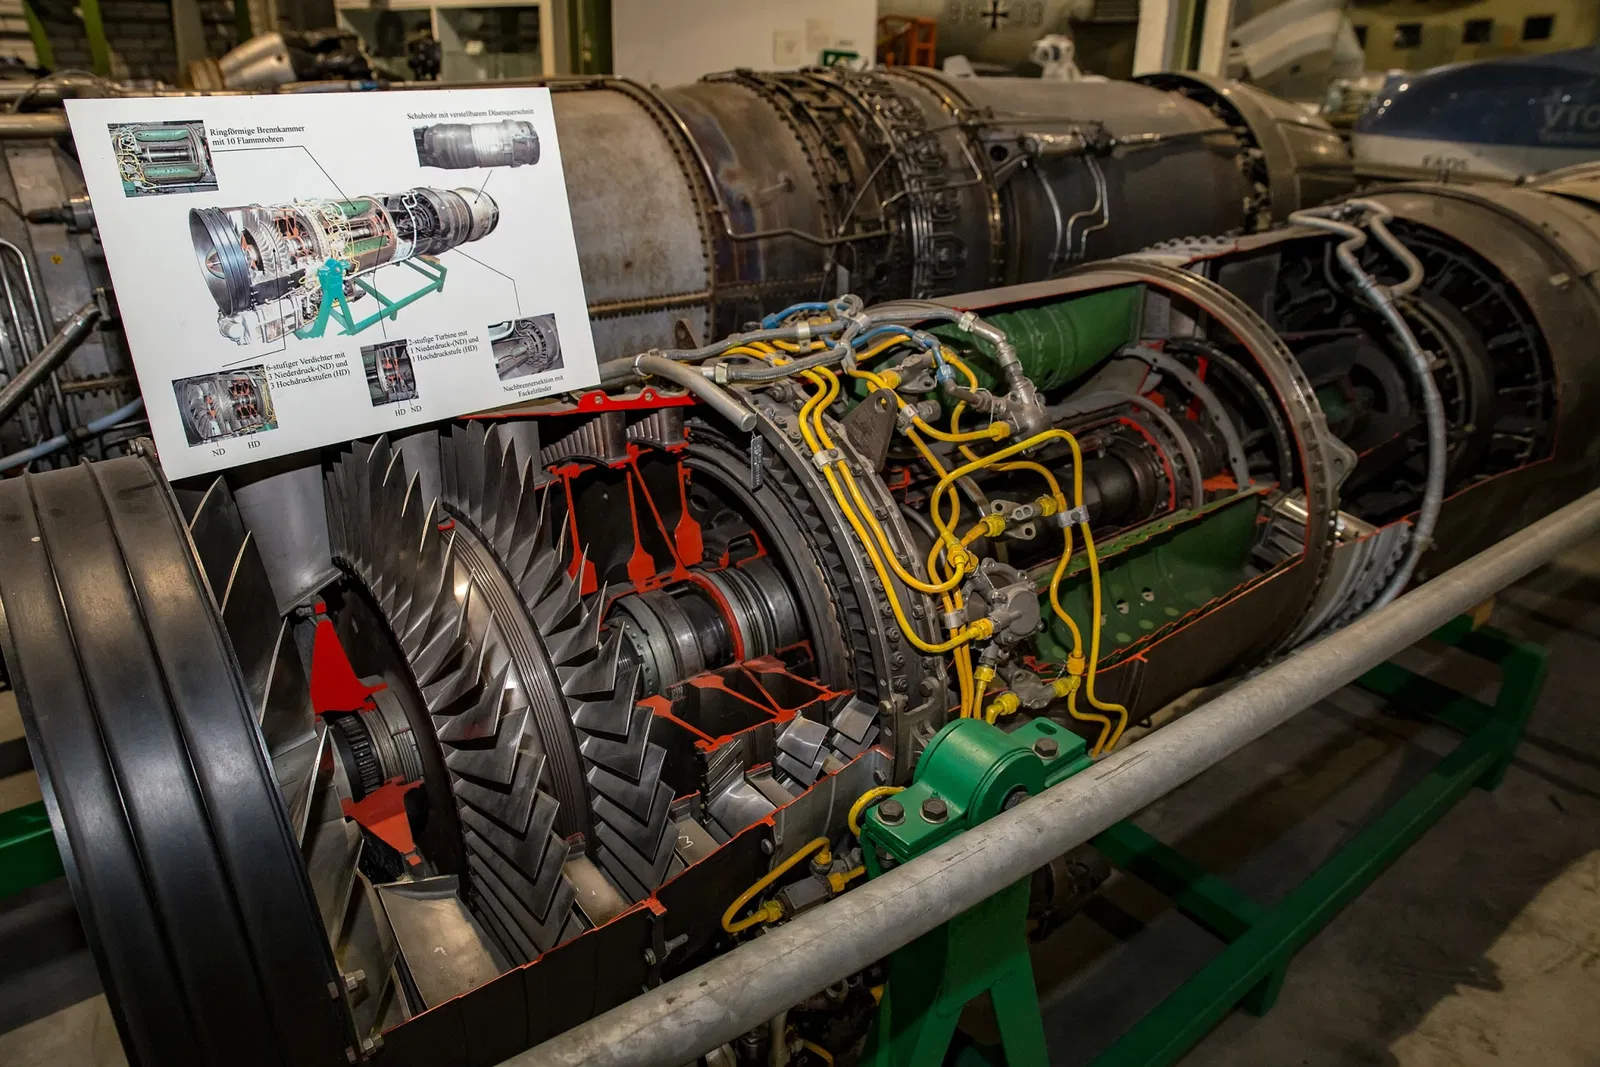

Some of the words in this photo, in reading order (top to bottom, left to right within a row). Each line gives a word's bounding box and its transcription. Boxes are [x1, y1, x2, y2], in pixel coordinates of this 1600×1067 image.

[407, 112, 437, 120] Schubrohr
[450, 110, 487, 118] verstellbarem
[210, 127, 255, 137] Ringförmige
[257, 125, 305, 134] Brennkammer
[238, 136, 284, 144] Flammrohren
[408, 336, 434, 345] 2-stufige
[435, 333, 457, 341] Turbine
[415, 338, 468, 352] Niederdruck-(ND)
[417, 348, 462, 361] Hochdruckstufe
[463, 345, 478, 354] (HD)
[265, 360, 298, 371] 6-stufiger
[299, 353, 333, 365] Verdichter
[274, 362, 334, 380] Niederdruck-(ND)
[336, 359, 348, 368] und
[276, 372, 332, 388] Hochdruckstufen
[333, 368, 351, 378] (HD)
[503, 377, 554, 392] Nachbrennersektion
[518, 385, 552, 397] Fackelzünder
[395, 408, 406, 416] HD
[410, 405, 422, 413] ND
[212, 448, 226, 457] ND
[247, 440, 261, 449] HD
